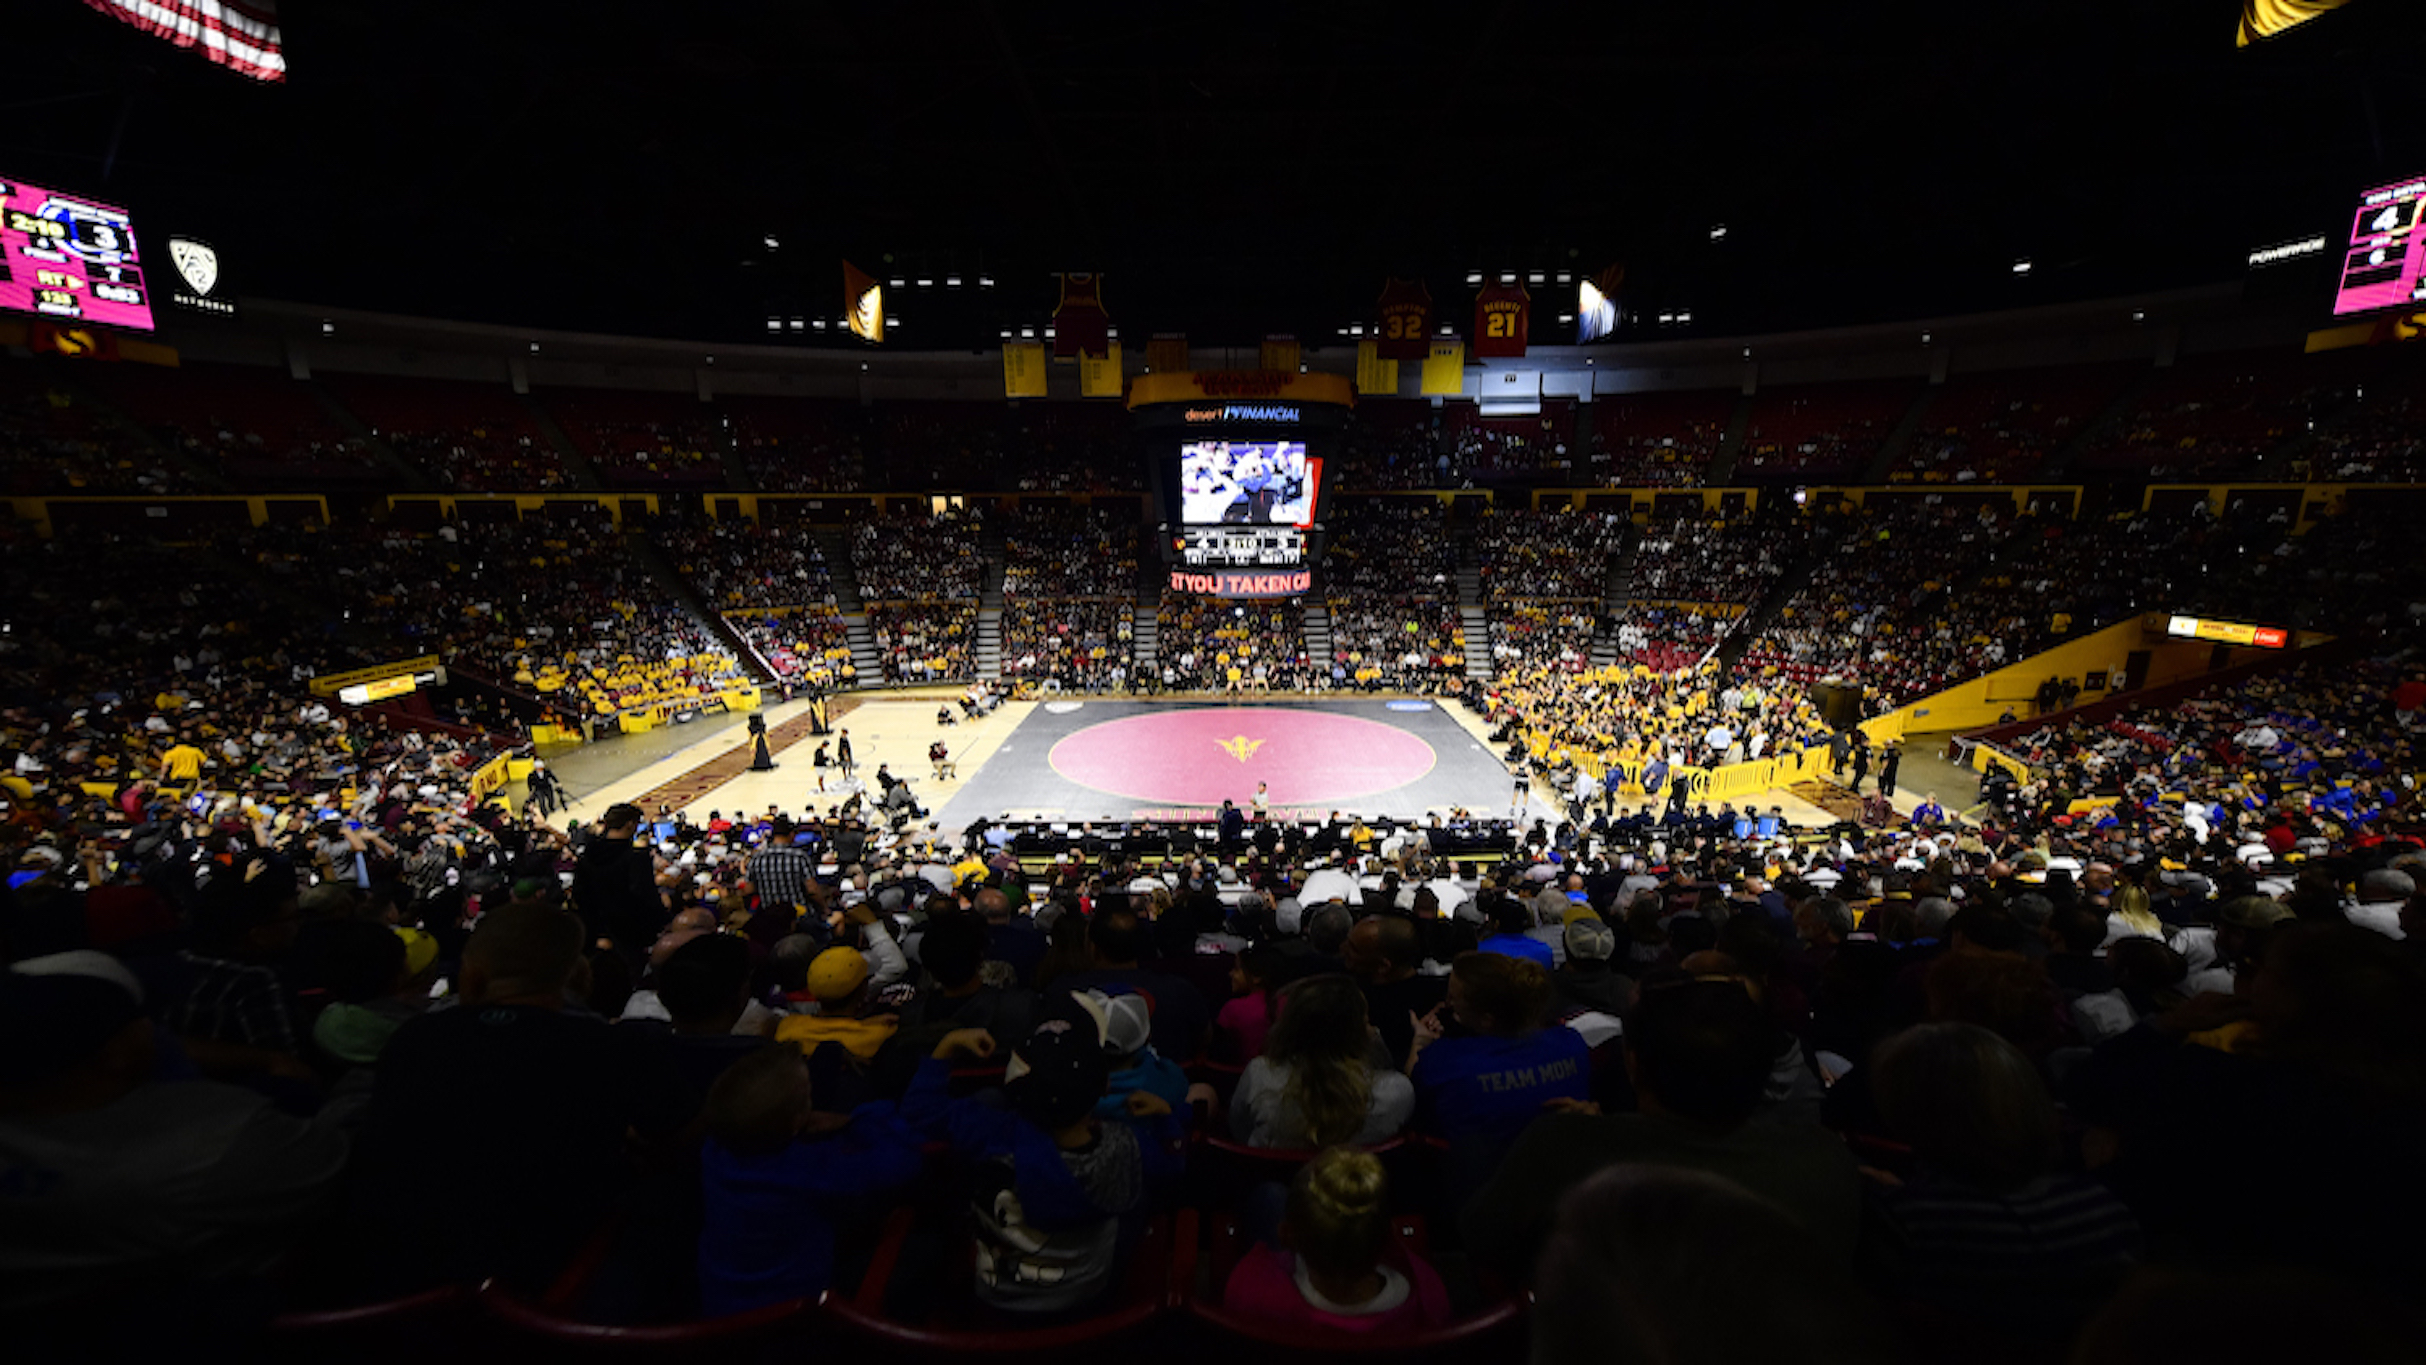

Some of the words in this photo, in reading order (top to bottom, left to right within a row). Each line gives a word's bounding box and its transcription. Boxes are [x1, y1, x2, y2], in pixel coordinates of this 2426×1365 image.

[2372, 207, 2398, 230] 4
[94, 225, 118, 249] 3
[1387, 315, 1422, 339] 32
[1487, 312, 1516, 337] 21
[1185, 573, 1224, 593] YOU
[1227, 574, 1292, 593] TAKEN
[1476, 1067, 1537, 1093] TEAM
[1538, 1057, 1578, 1084] MOM
